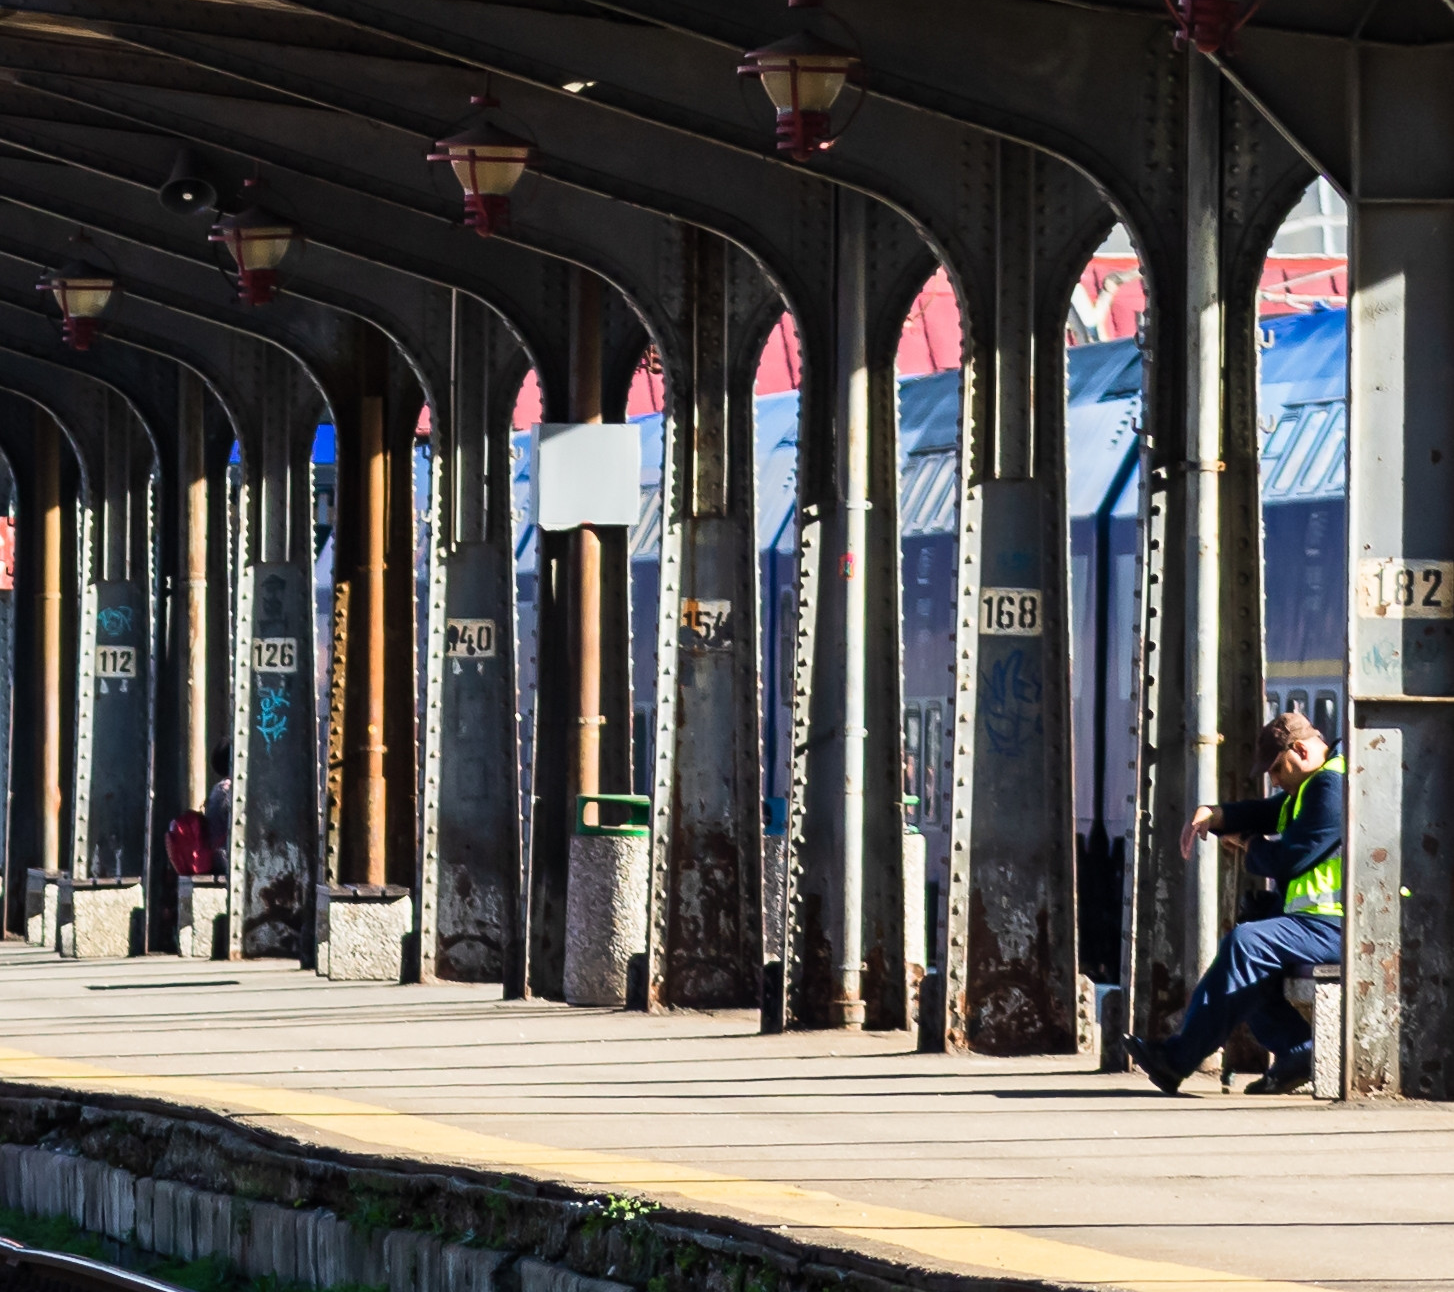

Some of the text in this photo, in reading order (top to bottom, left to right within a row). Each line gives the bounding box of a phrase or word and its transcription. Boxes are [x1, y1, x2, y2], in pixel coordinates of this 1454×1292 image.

[1373, 568, 1442, 607] 182
[982, 596, 1037, 629] 168
[99, 650, 132, 673] 112
[254, 643, 294, 668] 126
